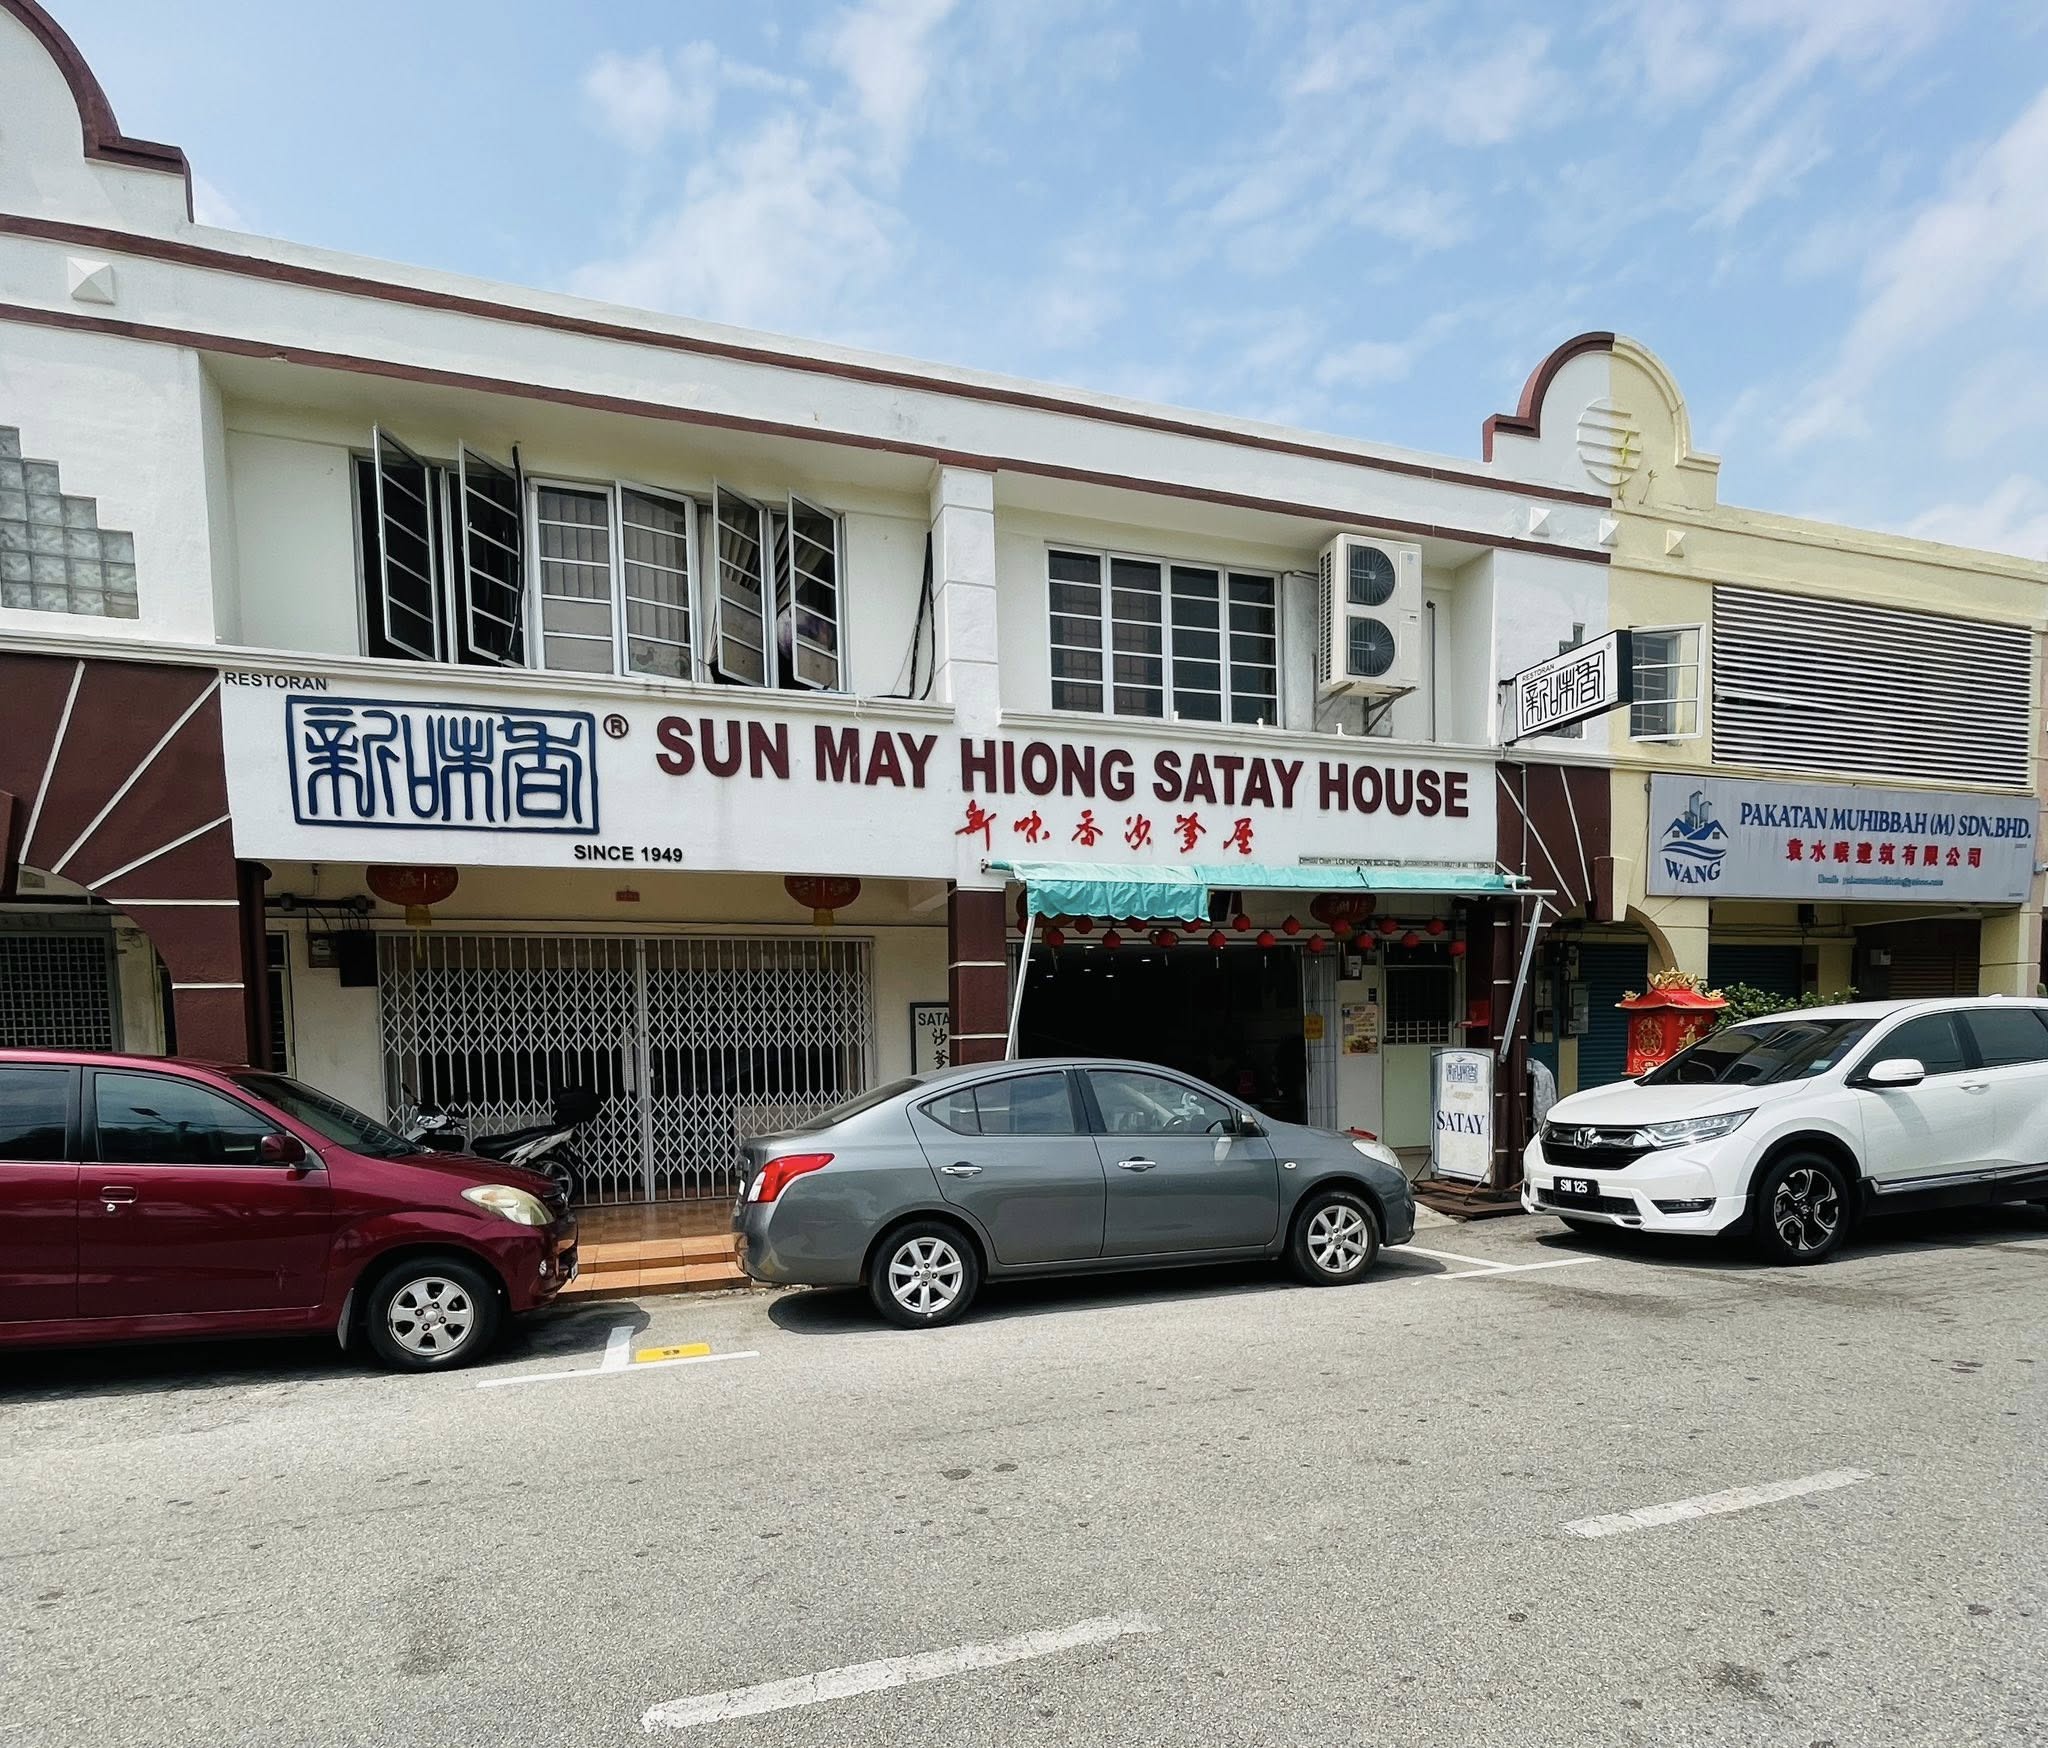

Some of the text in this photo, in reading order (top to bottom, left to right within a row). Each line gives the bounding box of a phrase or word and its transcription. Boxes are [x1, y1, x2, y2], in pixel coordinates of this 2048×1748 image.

[224, 672, 327, 691] RESTORAN
[656, 716, 1468, 818] SUN MAY HIONG SATAY HOUSE
[1740, 802, 1828, 829] PAKATAN
[1829, 806, 1928, 834] MUHIBBAH
[1929, 813, 1955, 837] (M)
[574, 844, 683, 863] SINCE 1949
[1664, 858, 1721, 884] WANG
[1436, 1110, 1485, 1135] SATAY
[1573, 1180, 1588, 1194] 125
